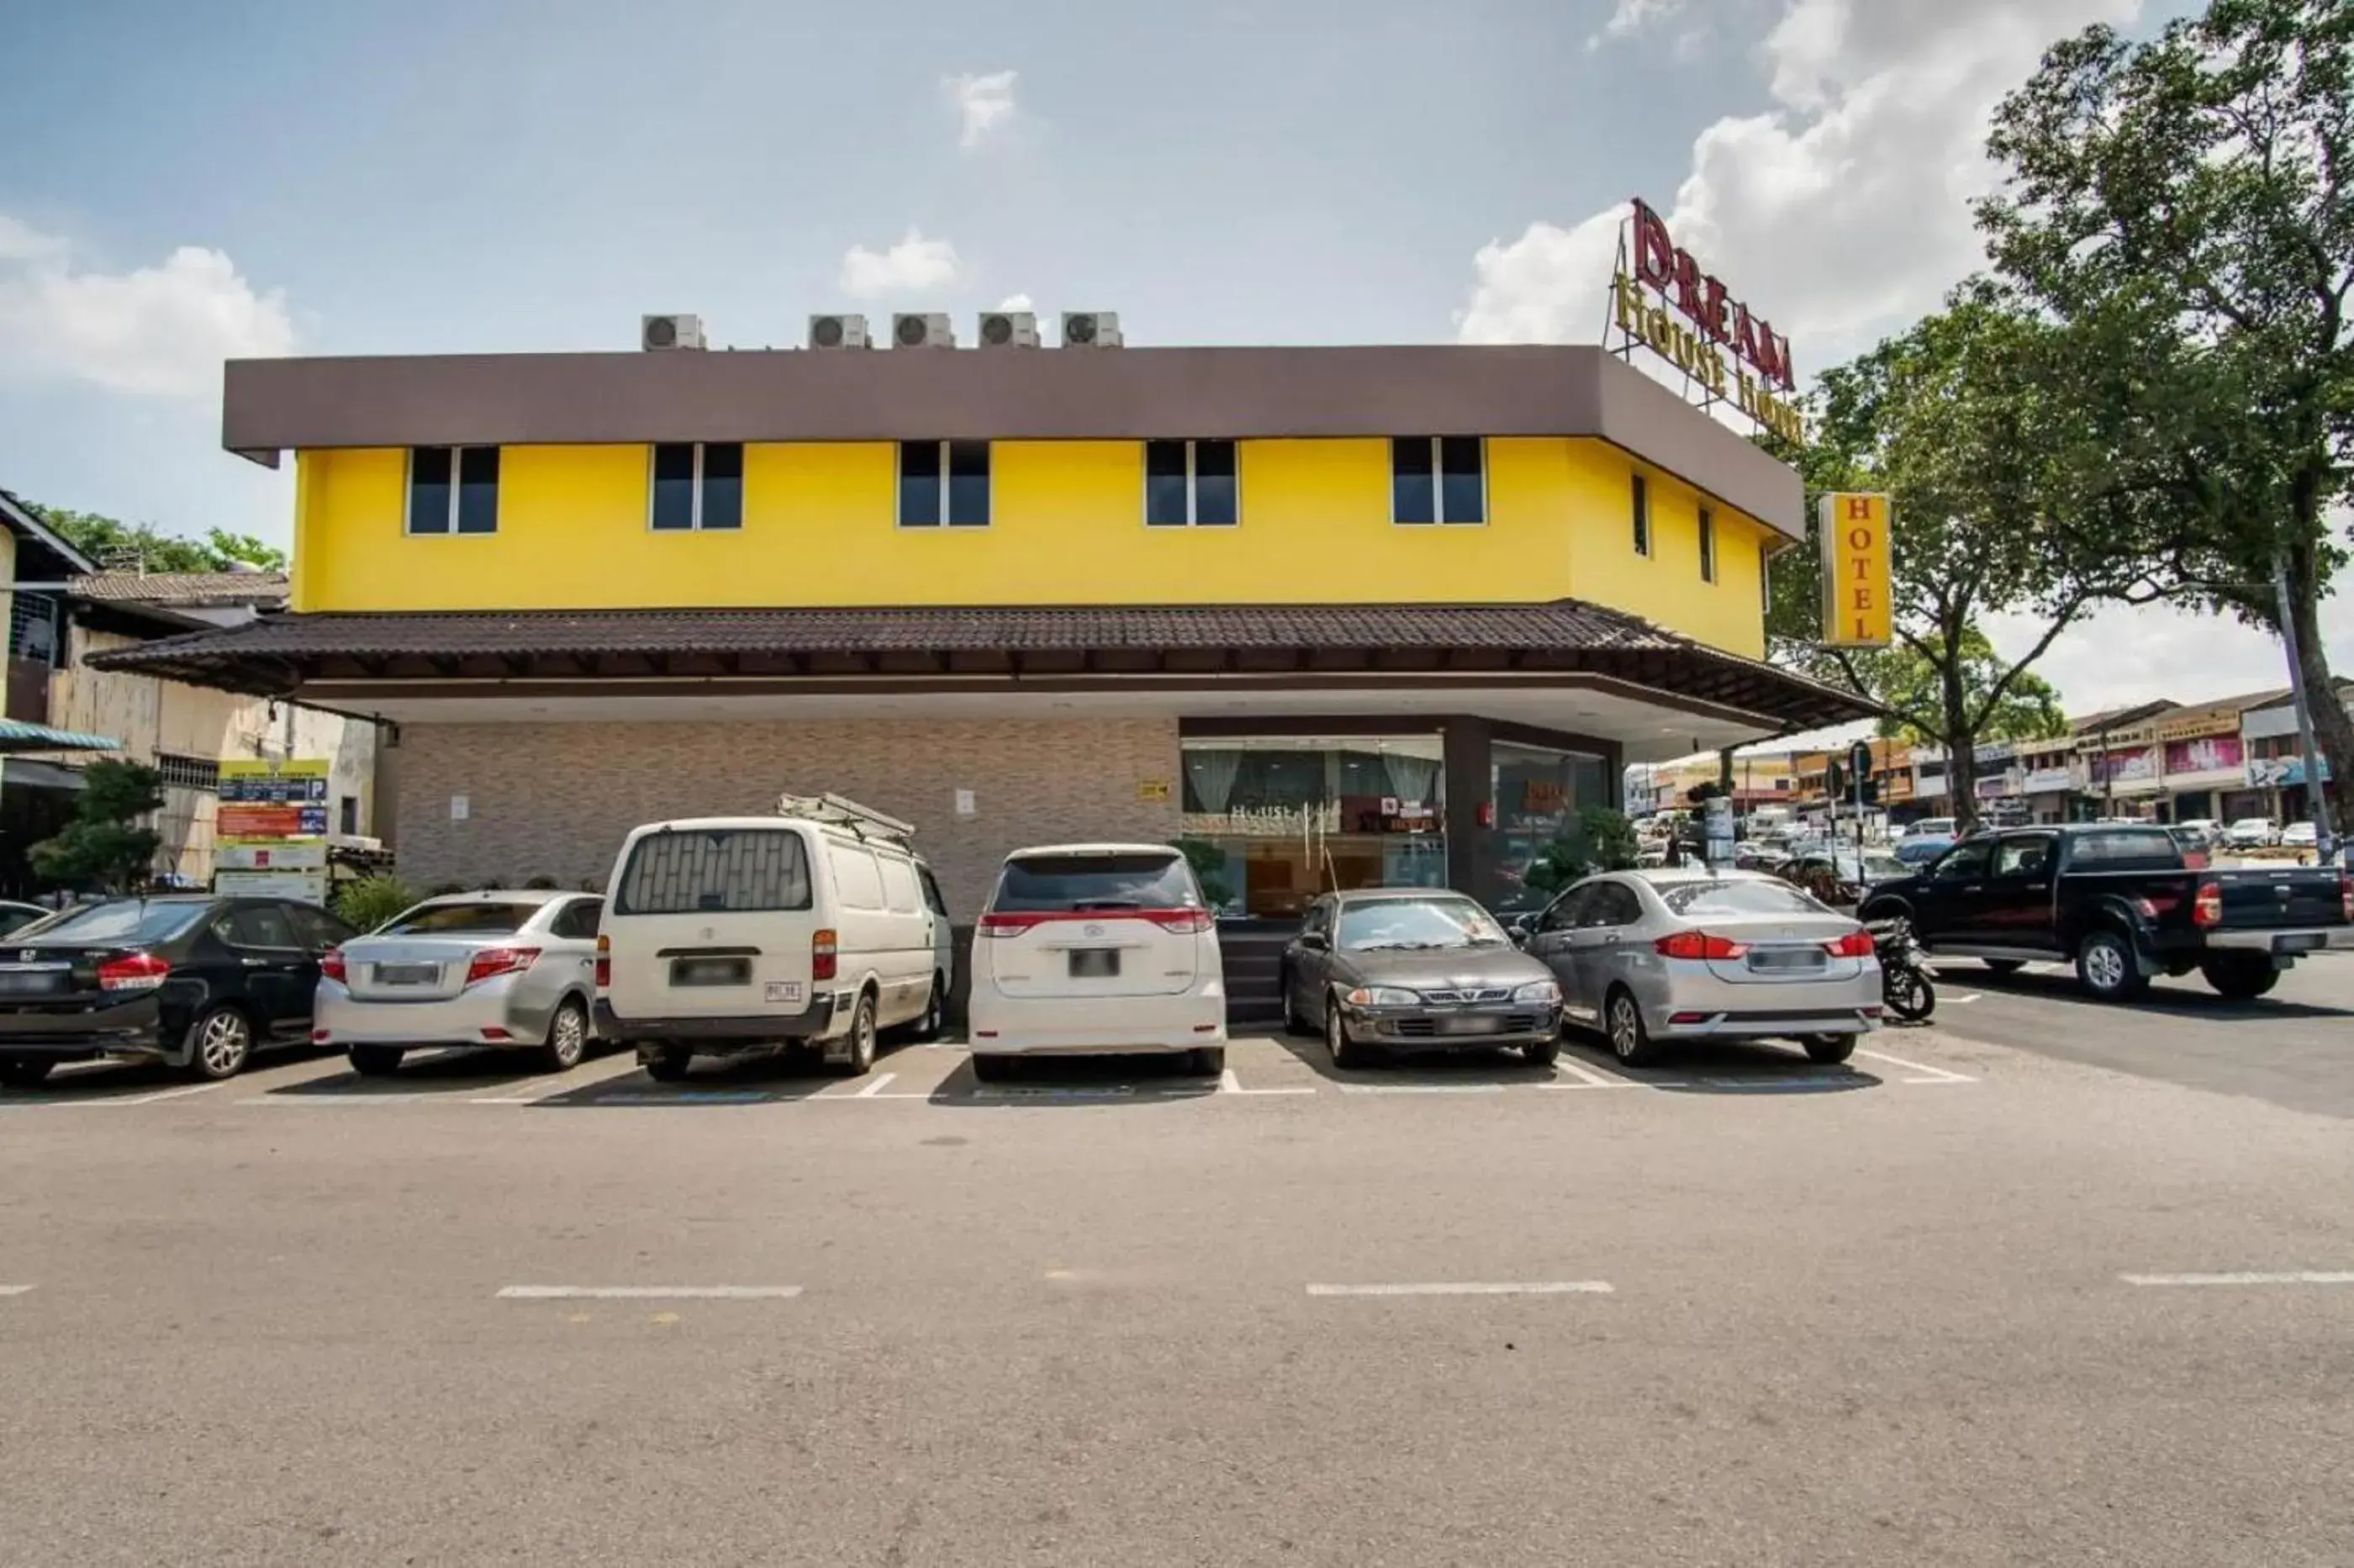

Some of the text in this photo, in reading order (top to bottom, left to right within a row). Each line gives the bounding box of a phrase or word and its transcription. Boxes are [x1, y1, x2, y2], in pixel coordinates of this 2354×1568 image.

[1615, 272, 1725, 399] HOUSE
[1633, 197, 1796, 393] DREAM
[1847, 498, 1873, 640] HOTEL
